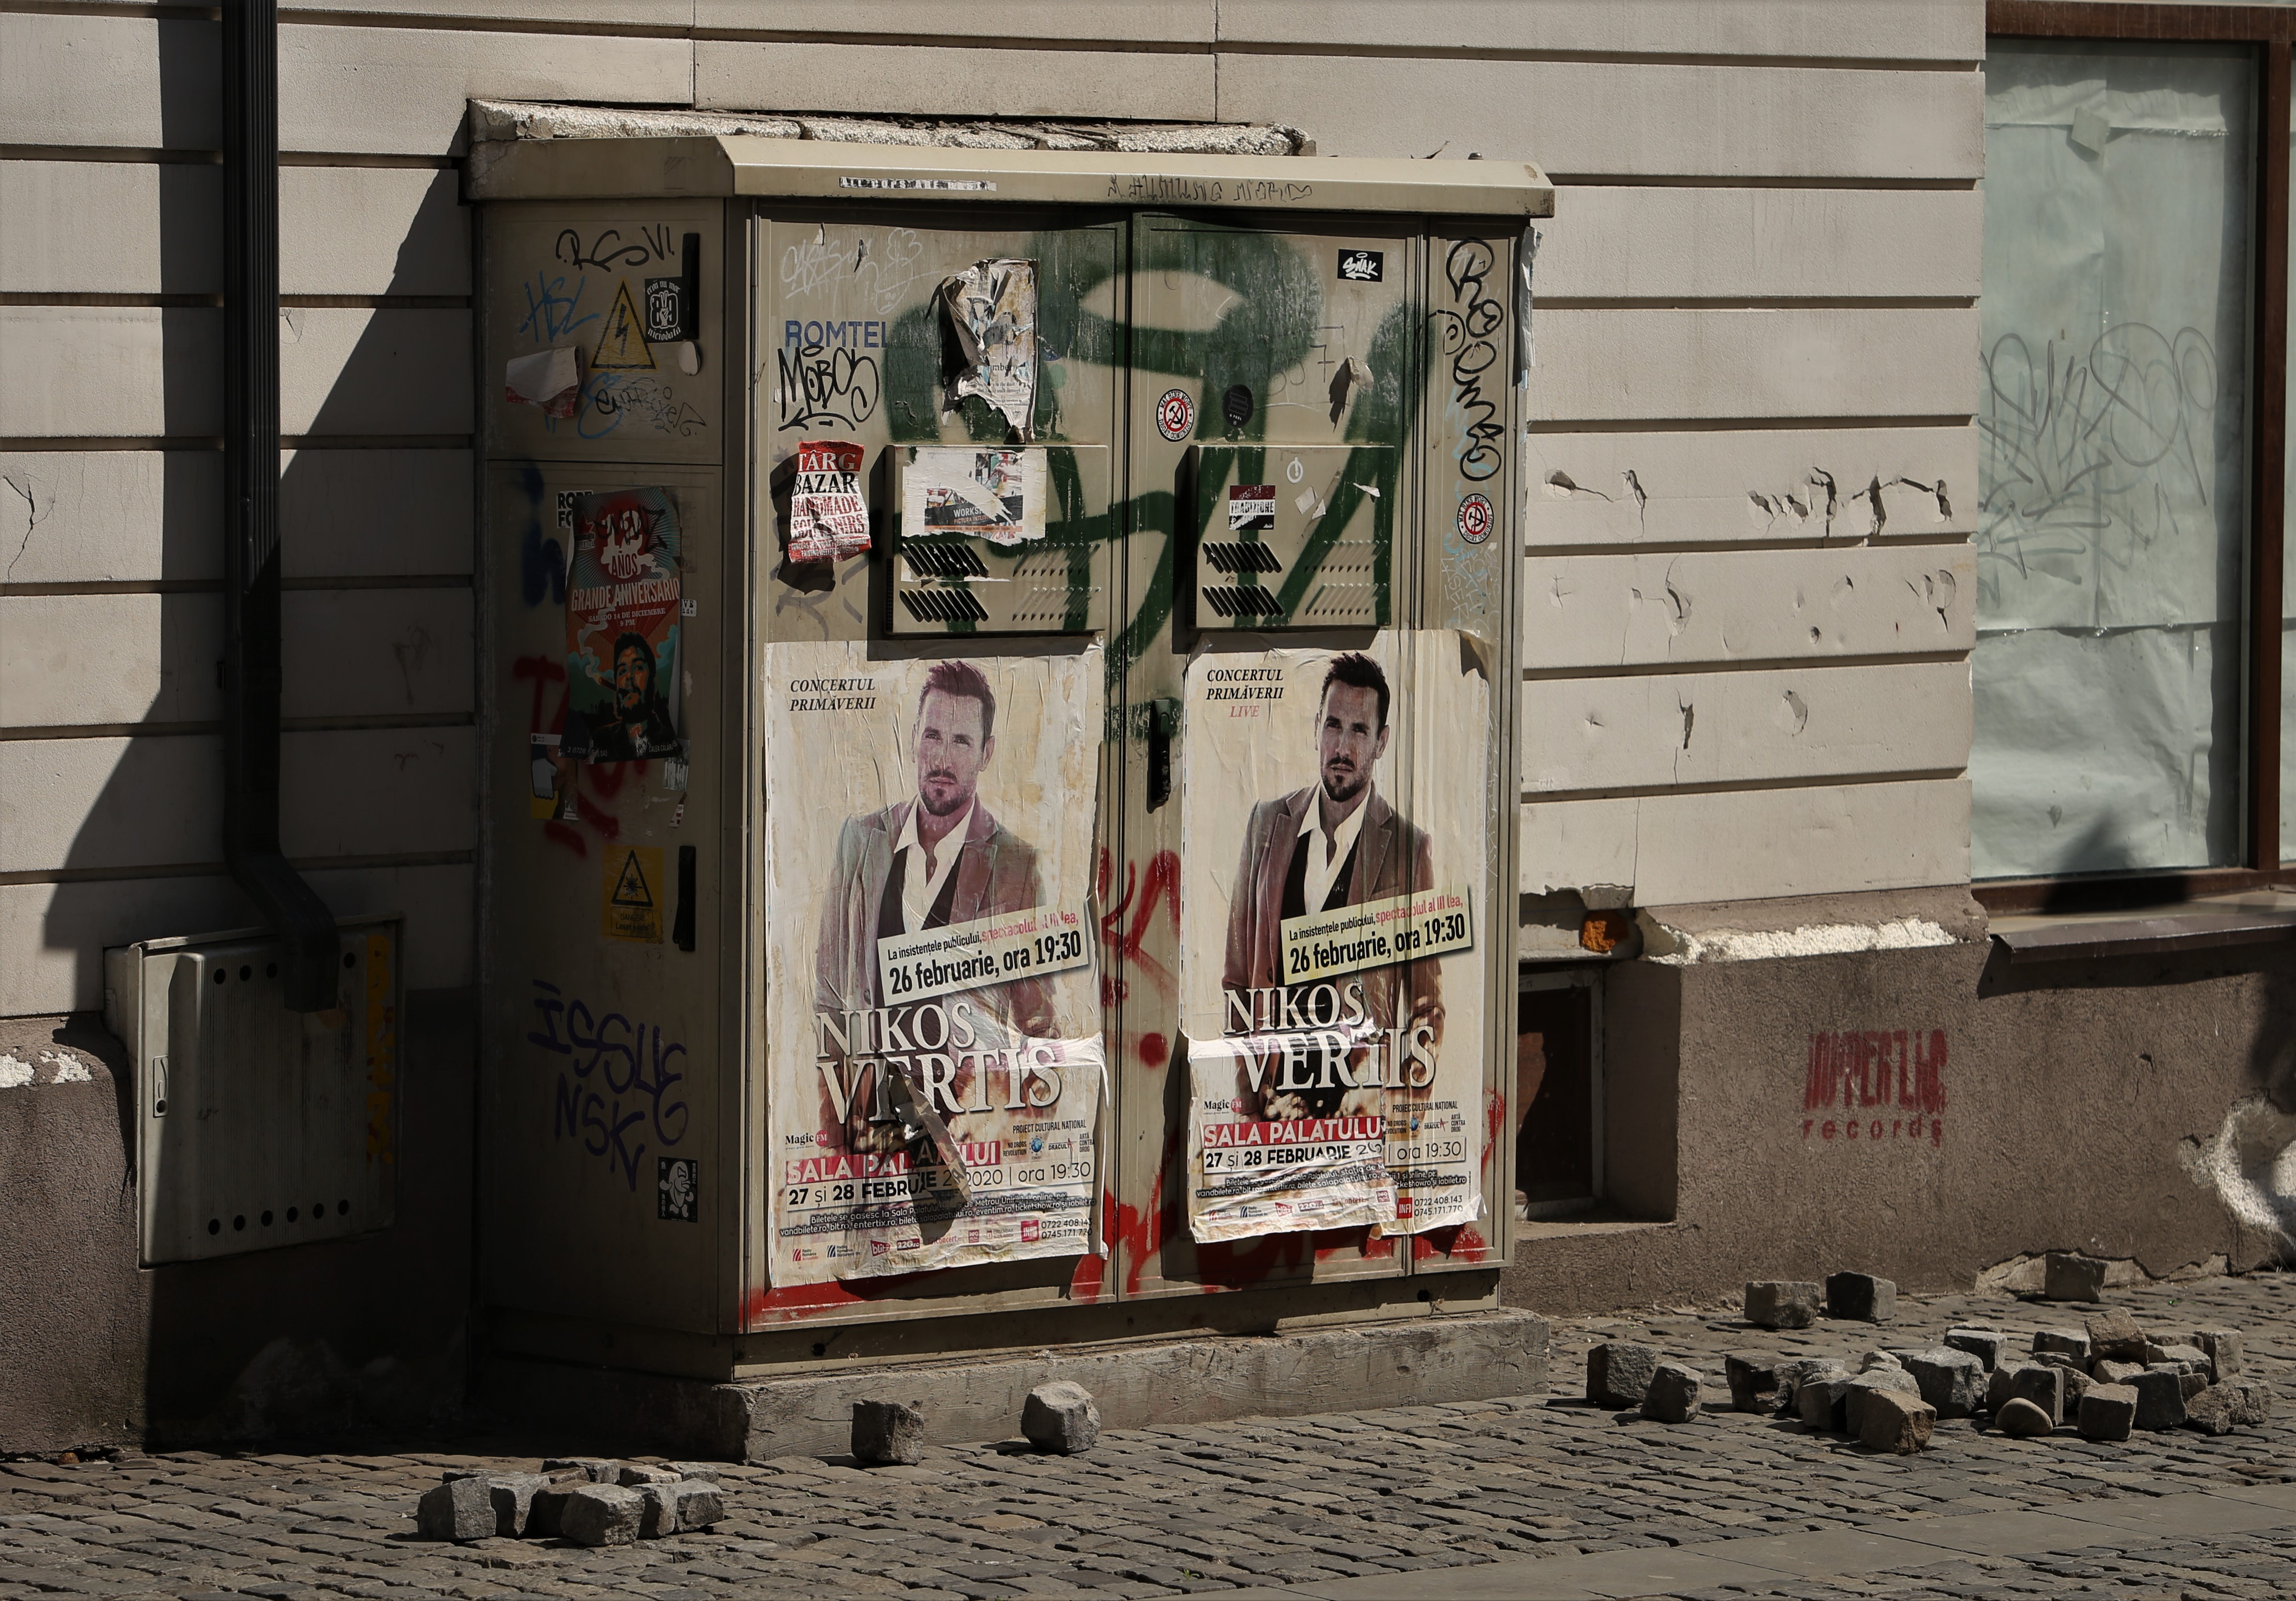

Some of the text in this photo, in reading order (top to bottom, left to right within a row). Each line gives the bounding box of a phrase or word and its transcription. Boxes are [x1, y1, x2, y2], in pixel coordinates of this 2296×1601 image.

[1342, 257, 1378, 276] SNAK
[669, 281, 680, 293] mor
[1160, 391, 1192, 410] MAI BINE MORT
[1171, 420, 1192, 440] COMUNIST
[799, 449, 856, 471] TÂRG
[794, 472, 857, 496] BAZAR
[793, 494, 863, 517] HANDMADE
[611, 550, 637, 576] AÑOS
[572, 577, 679, 612] GRANDE ANIVERSARIO
[588, 613, 612, 622] SÁBADO
[632, 607, 666, 617] DICIEMBRE
[1206, 668, 1283, 683] CONCERTUL
[790, 677, 876, 693] CONCERTUL
[1206, 683, 1283, 700] PRIMĂVERII
[789, 695, 876, 711] PRIMĂVERII
[1229, 705, 1260, 718] LIVE
[616, 922, 631, 930] Laser
[1289, 929, 1298, 941] La
[1299, 922, 1340, 939] insistențele
[1340, 912, 1376, 935] publicului,
[1428, 899, 1436, 912] al
[1437, 896, 1445, 911] III
[1447, 894, 1464, 910] lea,
[888, 949, 898, 960] La
[898, 940, 942, 957] insistențele
[943, 931, 982, 953] publicului,
[1290, 913, 1465, 974] 26 februarie, ora 19:30
[889, 930, 1082, 995] 26 februarie, ora 19:30
[1223, 982, 1367, 1034] NIKOS
[815, 1002, 975, 1058] NIKOS
[1204, 1099, 1230, 1111] Magic
[1412, 1102, 1434, 1112] CULTURAL
[1013, 1123, 1034, 1134] PROIECT
[1035, 1121, 1060, 1132] CULTURAL
[1204, 1117, 1382, 1147] SALA PALATULU
[785, 1133, 828, 1146] Magic FM
[1002, 1148, 1027, 1157] REVOLUTION
[1206, 1152, 1223, 1168] 27
[1228, 1151, 1239, 1172] și
[1244, 1150, 1262, 1165] 28
[1397, 1146, 1421, 1160] ora
[1426, 1141, 1462, 1158] 19:30
[787, 1156, 854, 1185] SALA
[789, 1188, 809, 1206] 27
[814, 1186, 827, 1207] și
[833, 1184, 854, 1201] 28
[1018, 1167, 1045, 1183] ora
[1050, 1161, 1091, 1180] 19:30
[1439, 1177, 1467, 1186] iabilet.ro
[974, 1198, 1000, 1207] Metrou
[1414, 1195, 1463, 1207] 0722.408.143
[780, 1224, 829, 1236] vandbilete.ro,
[829, 1222, 851, 1232] blt.ro,
[854, 1219, 898, 1230] entertix.ro,
[976, 1206, 1014, 1217] eventim.ro,
[1015, 1201, 1060, 1212] ticketshow.ro
[1068, 1198, 1096, 1208] iabilet.ro
[811, 1213, 838, 1224] Biletele
[850, 1212, 880, 1223] gasesc
[882, 1210, 890, 1218] la
[891, 1208, 908, 1217] Sala
[1414, 1204, 1463, 1217] 0745.171.770
[1041, 1228, 1093, 1240] 0745.171.770
